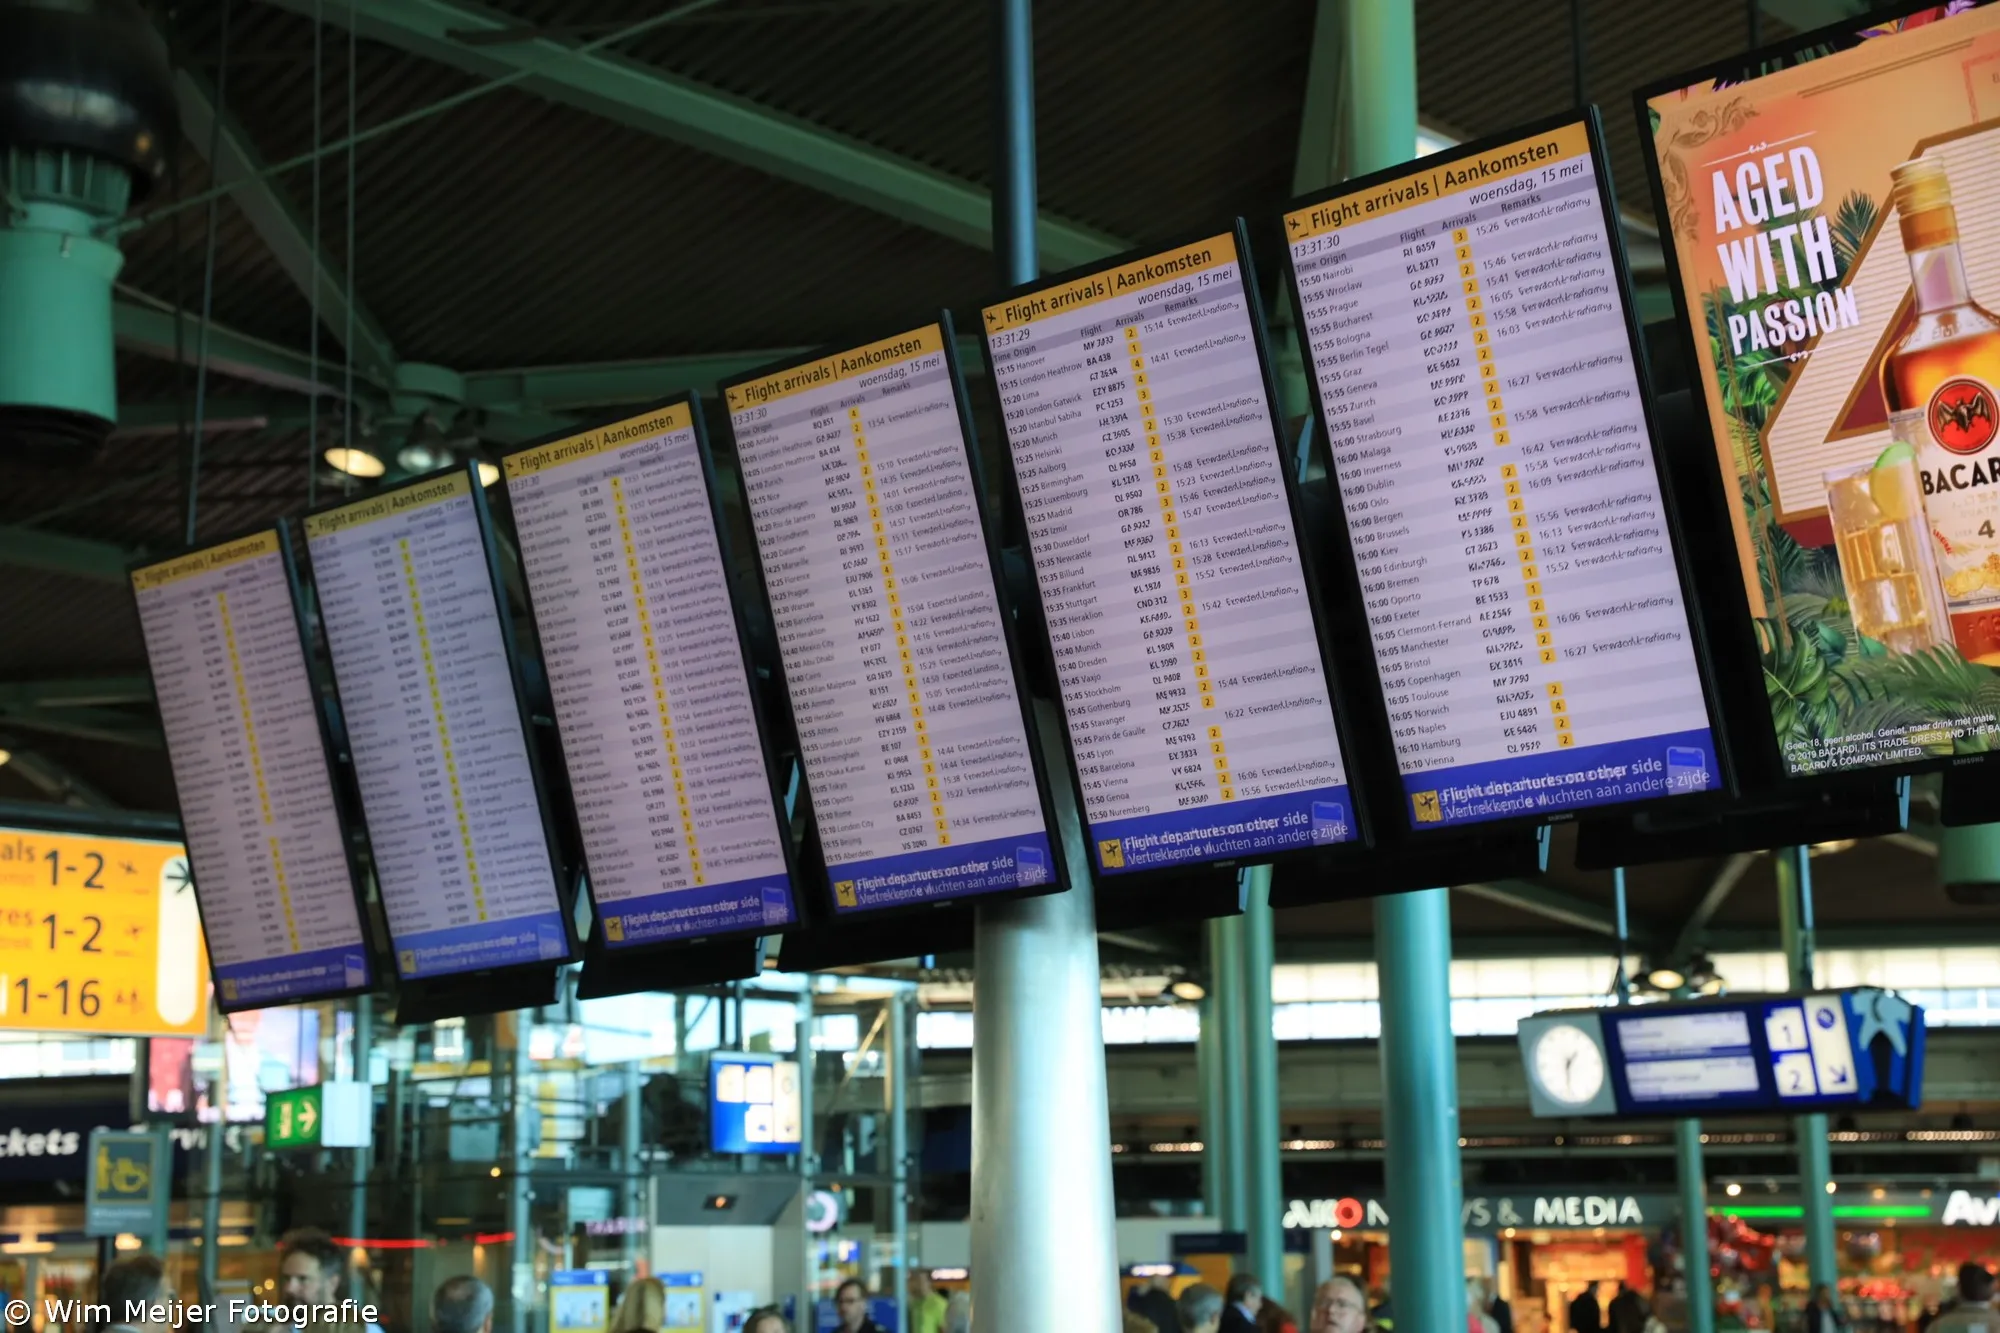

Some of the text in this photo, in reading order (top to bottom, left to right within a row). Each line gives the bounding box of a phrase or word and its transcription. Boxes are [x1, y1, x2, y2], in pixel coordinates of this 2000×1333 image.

[1310, 138, 1559, 233] Flight arrivals Aankomsten
[1712, 146, 1824, 234] AGED
[1292, 160, 1584, 258] 13:31:30 woensdag, 15 mei
[1296, 193, 1541, 273] Time Origin Flight Arrivals Remarks
[1717, 215, 1838, 305] WITH
[1004, 246, 1212, 326] Flight arrivals Aankomsten
[1299, 264, 1353, 288] 15:50 Nairobi
[990, 267, 1233, 349] 13:31:29 woensdag, 15 mei
[1305, 297, 1359, 320] 15:55 Prague
[1728, 285, 1860, 356] PASSION
[993, 295, 1198, 363] Time Origin Flight Arrivals Remarks
[1316, 341, 1389, 368] 15:55 Berlin Tegel
[744, 336, 922, 405] Flight arrivals Aankomsten
[858, 365, 907, 390] woensdag,
[909, 362, 920, 372] 15
[921, 355, 940, 369] mei
[999, 360, 1082, 391] 15:15 London Heathrow
[519, 412, 673, 474] Flight arrivals Aankomsten
[1011, 431, 1057, 450] 15:20 Munich
[1343, 477, 1395, 497] 16:00 Dublin
[1027, 505, 1072, 524] 15:25 Madrid
[1042, 579, 1096, 598] 15:35 Frankfurt
[1367, 590, 1421, 609] 16:00 Oporto
[1377, 636, 1449, 657] 16:05 Manchester
[1064, 683, 1121, 701] 15:45 Stockholm
[1384, 668, 1462, 689] 16:05 Copenhagen
[1785, 740, 1807, 750] Geen
[1823, 736, 1844, 747] geen
[1908, 723, 1930, 732] maar
[1931, 719, 1952, 729] drink
[1954, 717, 1971, 726] met
[1796, 750, 1816, 760] 2019
[1861, 741, 1876, 750] ITS
[1877, 736, 1909, 748] TRADE
[1909, 732, 1942, 744] DRESS
[1943, 728, 1964, 739] AND
[1966, 726, 1985, 736] THE
[1401, 753, 1454, 770] 16:10 Vienna
[1590, 762, 1627, 781] other
[1630, 756, 1663, 775] side
[1790, 746, 1923, 773] BACARDI & COMPANY LIMITED.
[1596, 784, 1621, 798] aan
[1623, 773, 1674, 794] andere
[1675, 768, 1711, 790] zijde
[1245, 815, 1279, 832] other
[1281, 811, 1308, 827] side
[1253, 835, 1274, 847] aan
[1276, 826, 1318, 844] andere
[1318, 822, 1349, 840] zijde
[44, 850, 105, 889] 1-2
[960, 859, 989, 874] other
[991, 855, 1014, 870] side
[966, 878, 985, 889] aan
[986, 870, 1022, 886] andere
[1022, 866, 1048, 883] zijde
[42, 914, 103, 953] 1-2
[15, 977, 101, 1017] 1-16
[1534, 1196, 1644, 1227] MEDIA
